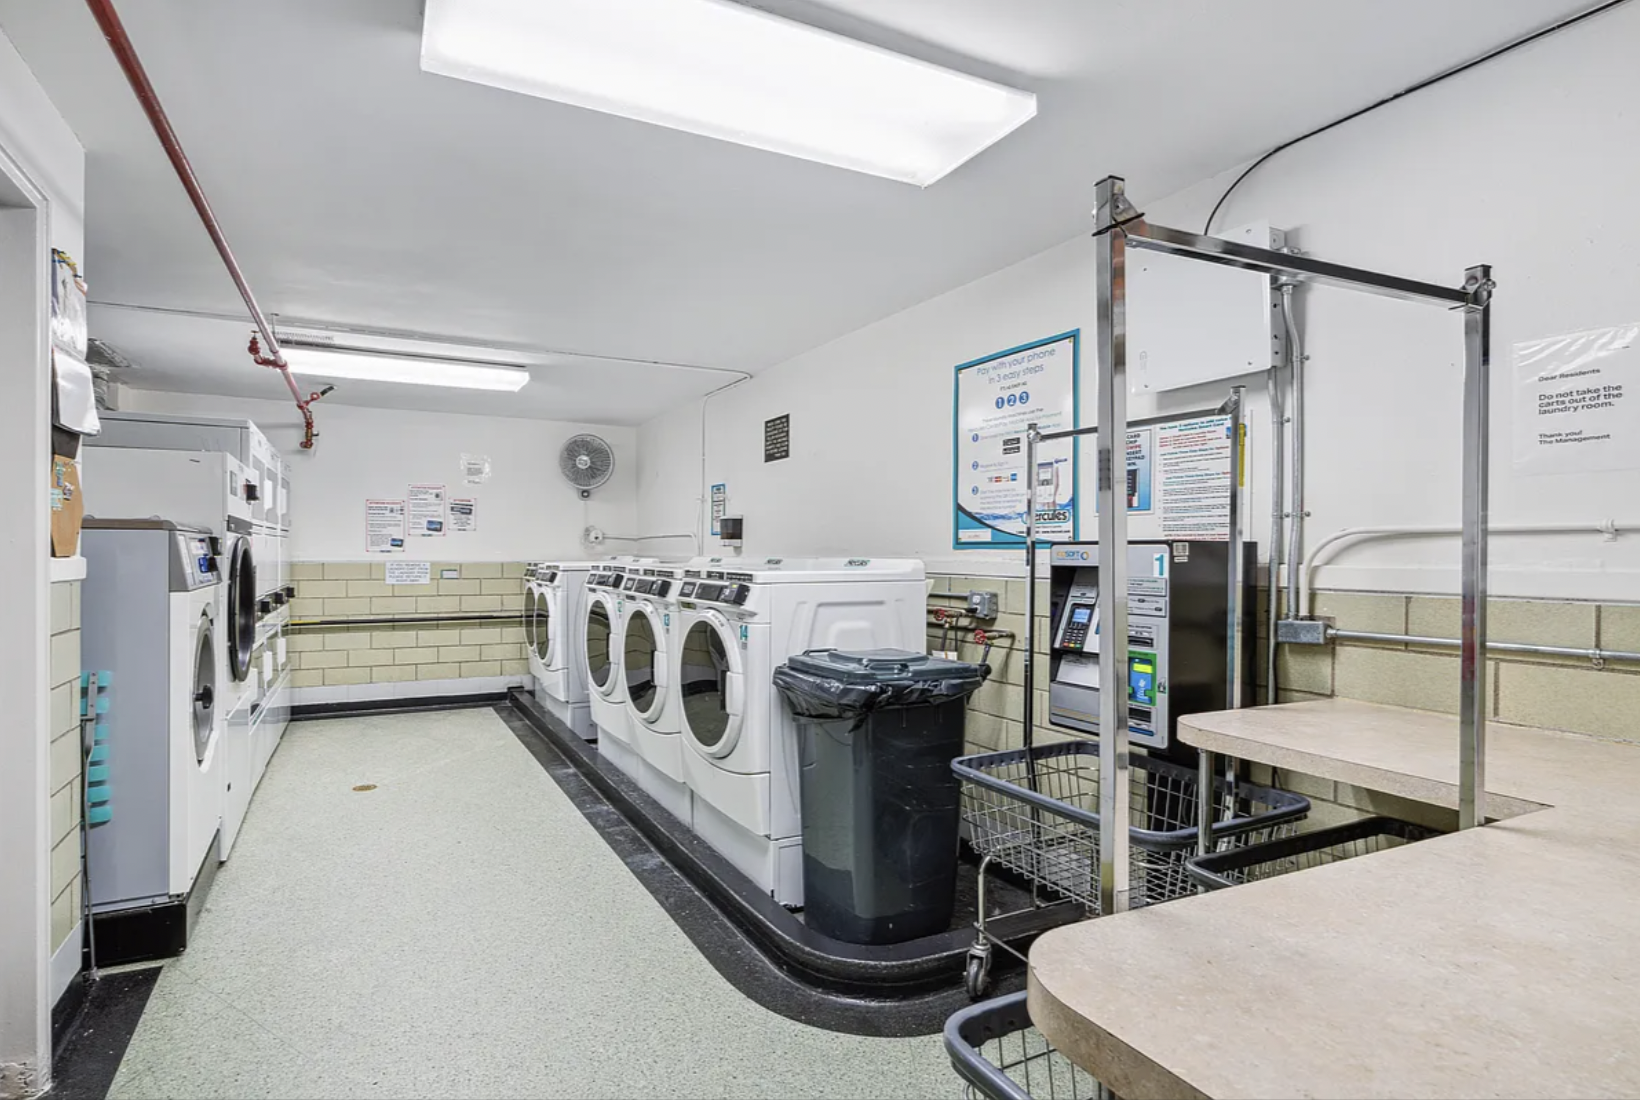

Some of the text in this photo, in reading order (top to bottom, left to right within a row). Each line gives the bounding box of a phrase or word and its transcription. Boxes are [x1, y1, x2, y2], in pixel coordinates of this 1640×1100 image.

[991, 362, 1006, 371] with
[1008, 356, 1025, 368] your
[1027, 349, 1055, 362] phone
[996, 374, 1001, 382] 3
[1003, 371, 1021, 380] easy
[1022, 364, 1044, 375] steps
[1559, 368, 1600, 379] Residents
[1556, 391, 1574, 399] not
[1576, 388, 1600, 396] take
[1539, 400, 1566, 408] carts
[1588, 394, 1601, 402] of
[1539, 402, 1615, 415] laundry room.
[1555, 434, 1610, 443] Management
[1035, 511, 1067, 521] ercules
[1155, 554, 1164, 576] 1
